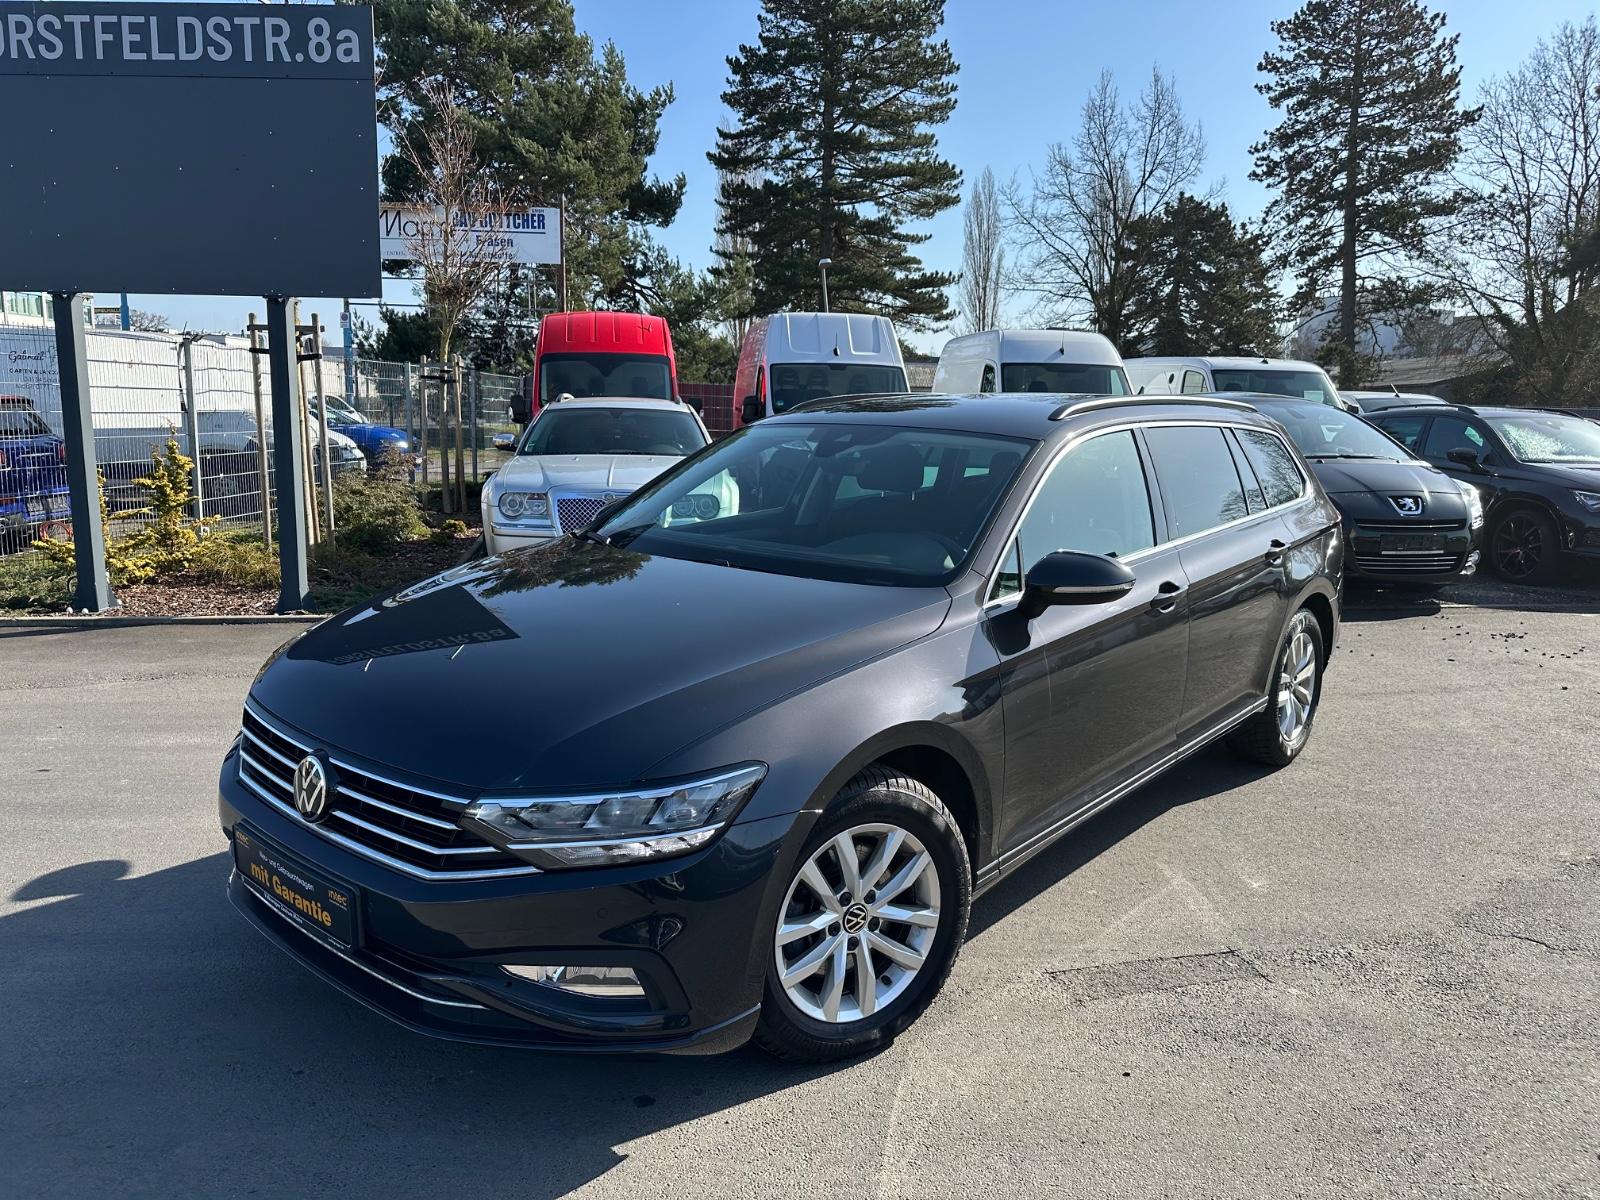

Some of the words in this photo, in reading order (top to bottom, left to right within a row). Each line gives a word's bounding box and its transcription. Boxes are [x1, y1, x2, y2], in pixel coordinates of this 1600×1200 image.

[0, 13, 361, 64] RSTFELDSTR.8a
[250, 862, 271, 887] mit
[272, 874, 332, 927] Garantie
